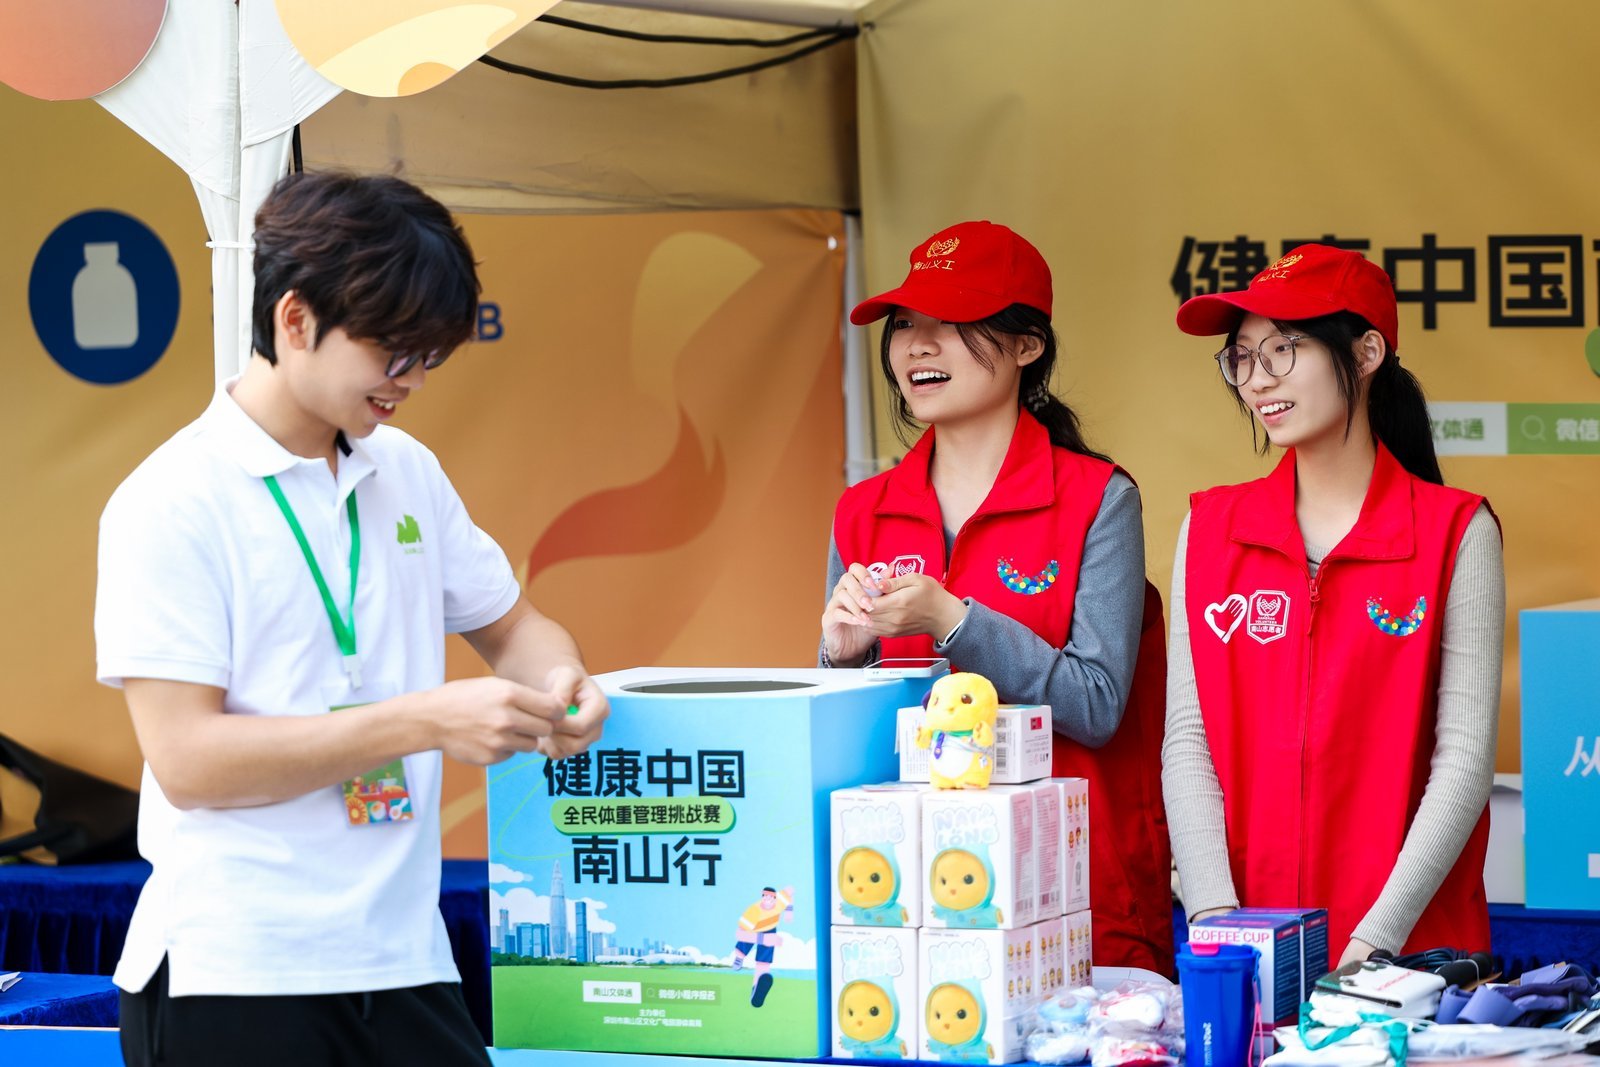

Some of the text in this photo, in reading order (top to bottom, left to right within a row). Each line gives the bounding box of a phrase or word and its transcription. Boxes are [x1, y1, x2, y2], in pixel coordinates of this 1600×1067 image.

[543, 748, 746, 798] 健康中国
[563, 804, 721, 825] 全民体重管理挑战赛
[571, 835, 723, 886] 南山行
[1192, 929, 1241, 942] COFFEE
[1243, 931, 1270, 944] CUP
